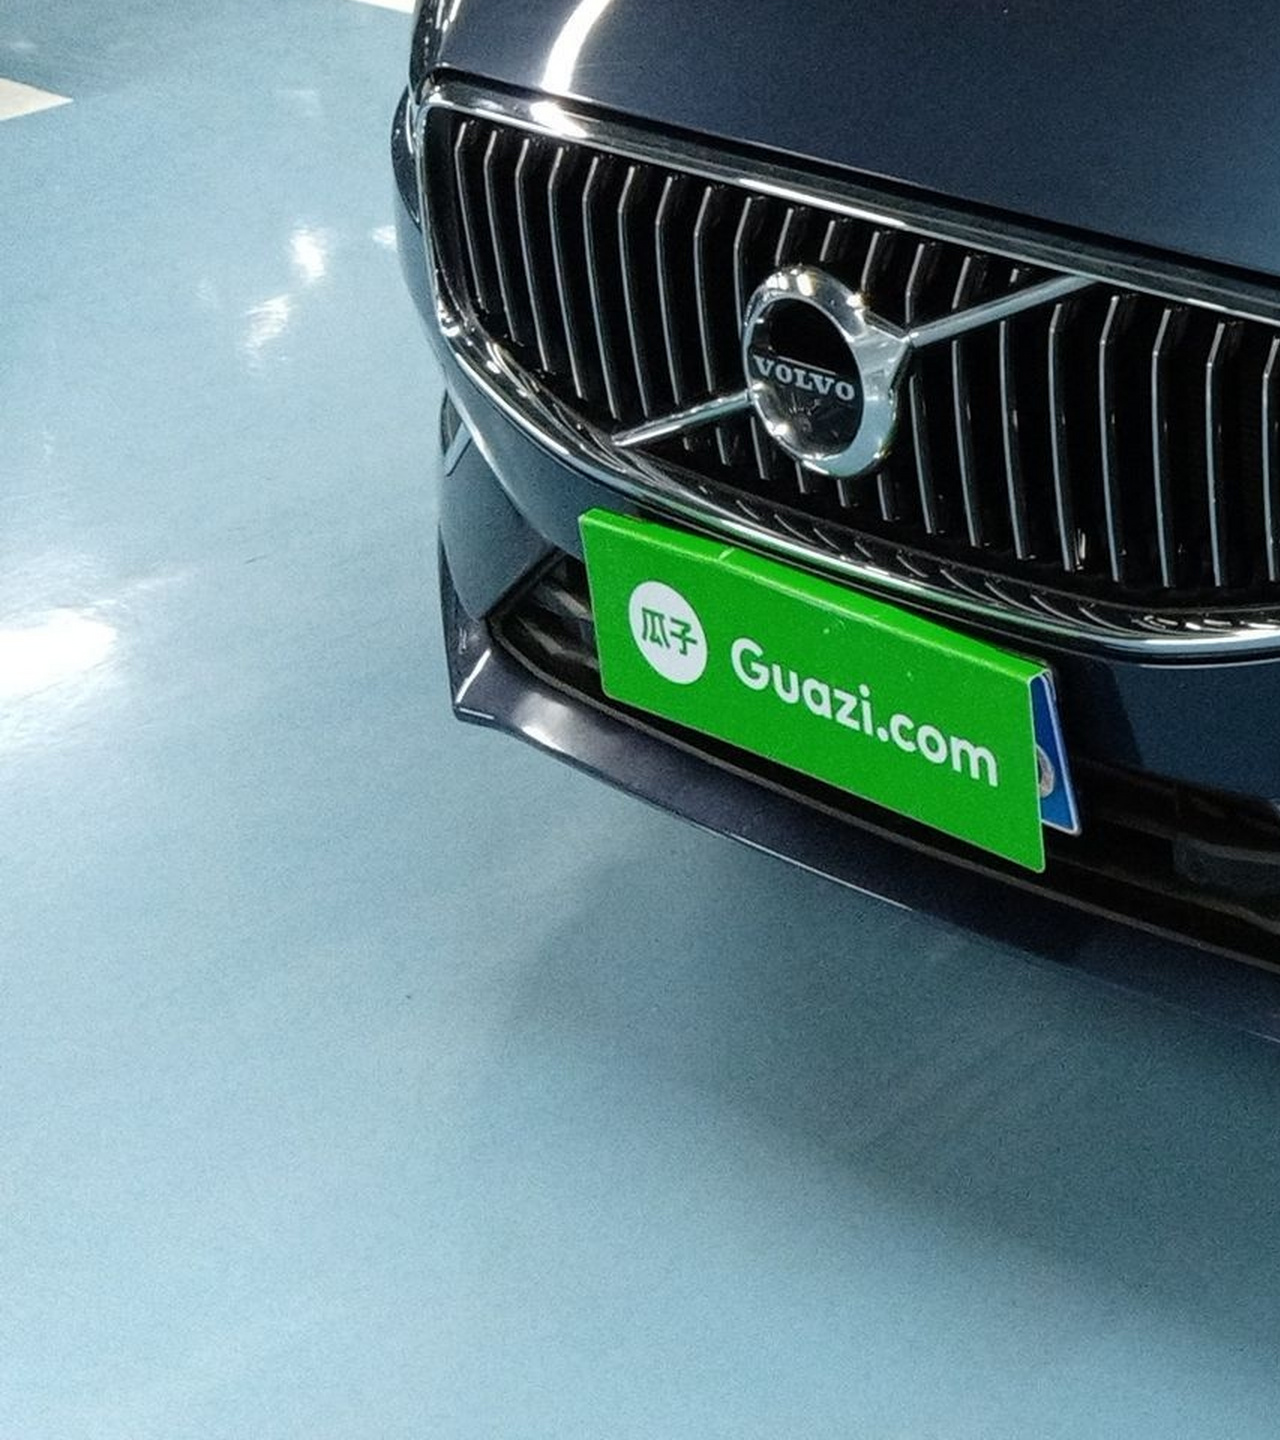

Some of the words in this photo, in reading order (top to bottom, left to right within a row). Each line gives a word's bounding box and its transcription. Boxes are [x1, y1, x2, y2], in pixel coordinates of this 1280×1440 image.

[753, 354, 855, 401] VOLVO
[641, 607, 698, 656] 瓜子
[731, 637, 998, 787] Guazi.com
